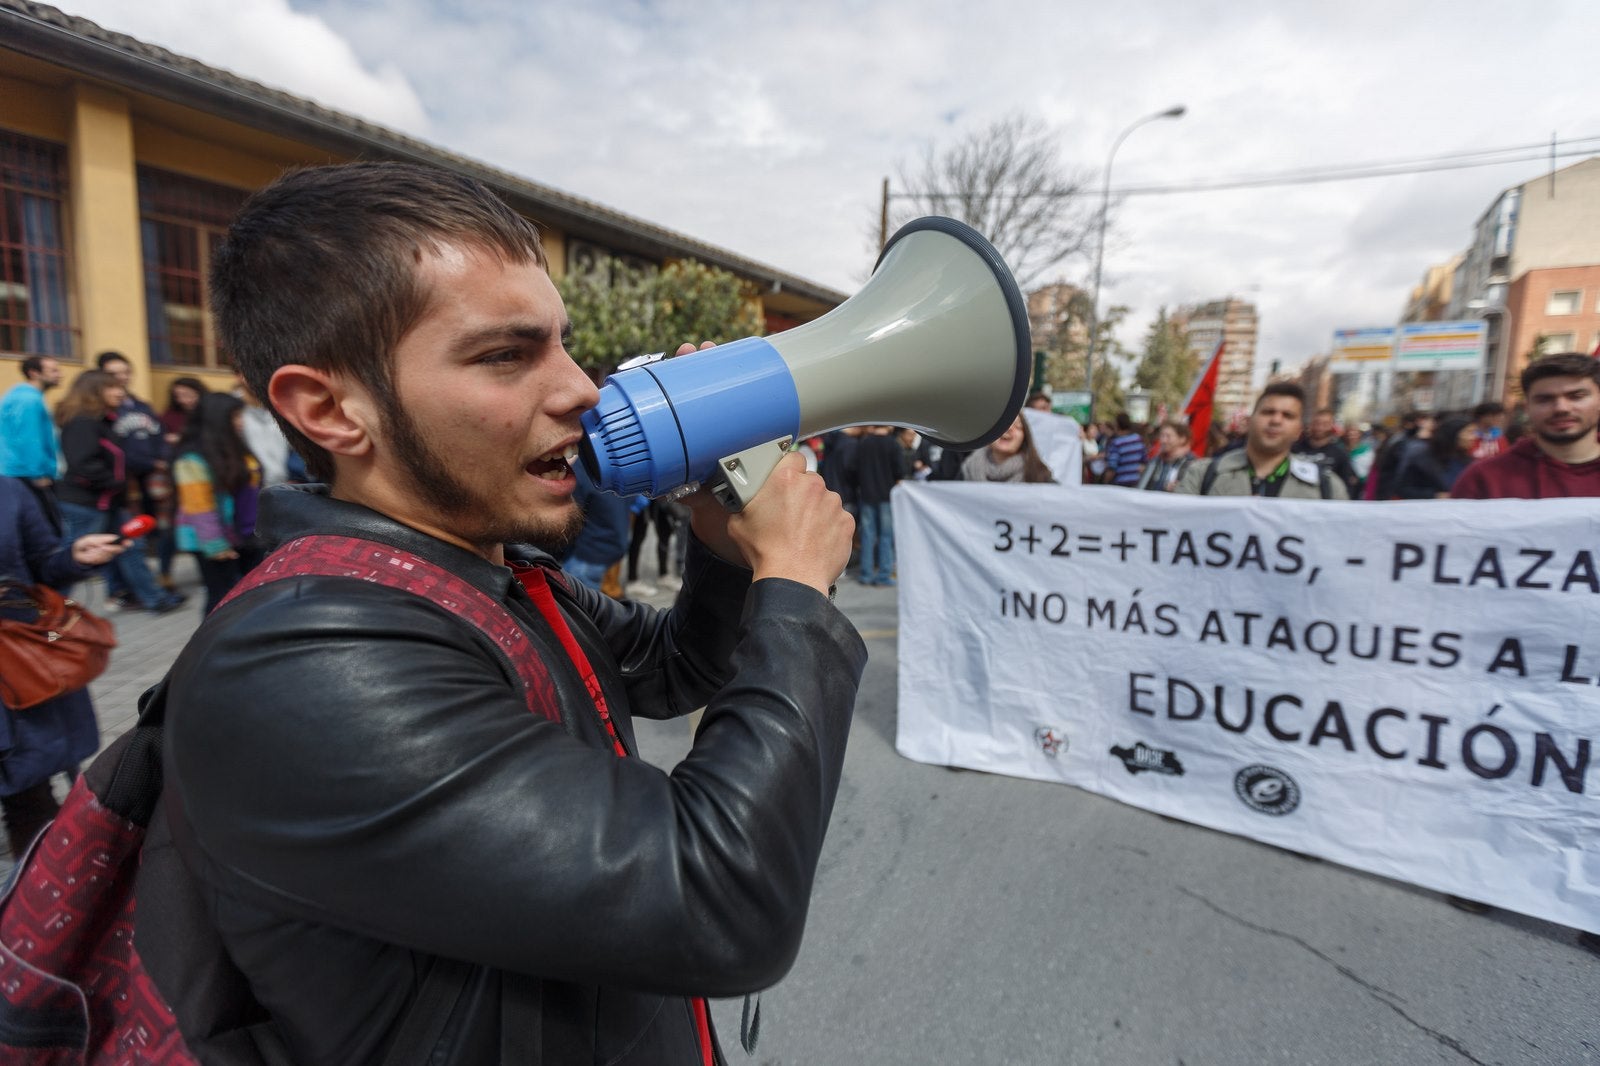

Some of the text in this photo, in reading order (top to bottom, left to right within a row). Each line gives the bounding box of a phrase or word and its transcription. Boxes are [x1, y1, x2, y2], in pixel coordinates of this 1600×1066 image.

[1390, 541, 1600, 595] PLAZA
[1086, 588, 1180, 638] MÁS
[1199, 609, 1463, 670] ATAQUES
[1486, 636, 1529, 679] A
[1558, 644, 1600, 687] L
[1128, 671, 1592, 795] EDUCACIÓN
